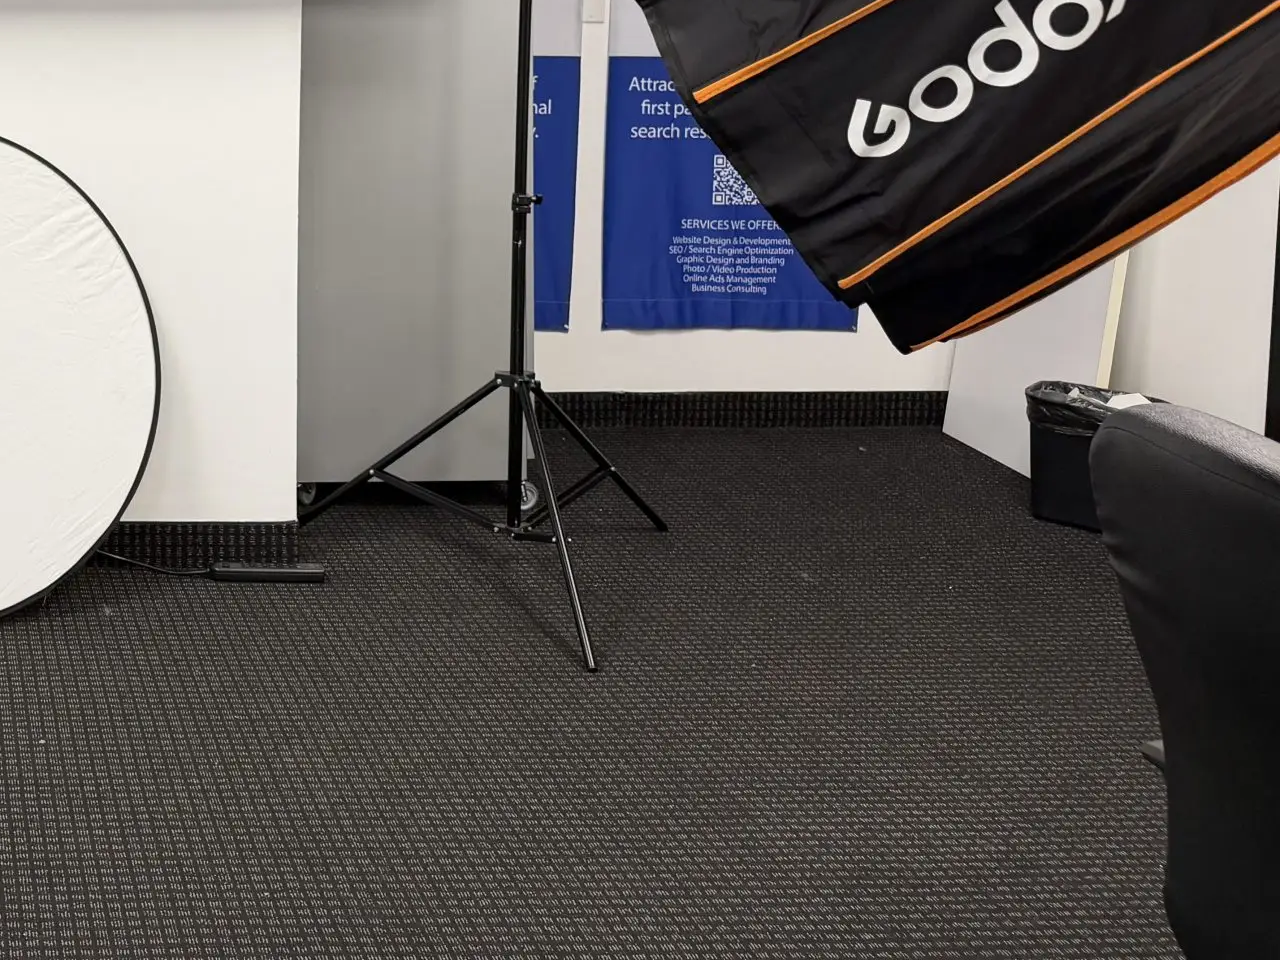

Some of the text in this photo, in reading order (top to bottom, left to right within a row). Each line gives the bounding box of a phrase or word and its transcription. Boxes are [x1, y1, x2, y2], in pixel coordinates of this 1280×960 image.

[628, 76, 676, 92] Attrac
[641, 99, 671, 115] first
[630, 123, 708, 139] search res
[681, 219, 729, 230] SERVICES
[730, 219, 746, 230] WE
[672, 235, 792, 247] Website Design & Development
[668, 245, 683, 254] SEO
[688, 245, 716, 254] Search
[717, 246, 744, 256] Engine
[744, 246, 794, 256] Optimization
[676, 255, 785, 267] Graphic Design and Branding
[683, 265, 706, 273] Photo
[711, 265, 735, 274] Video
[736, 265, 777, 274] Production
[683, 274, 776, 286] Online Ads Management
[691, 284, 767, 295] Business Consulting
